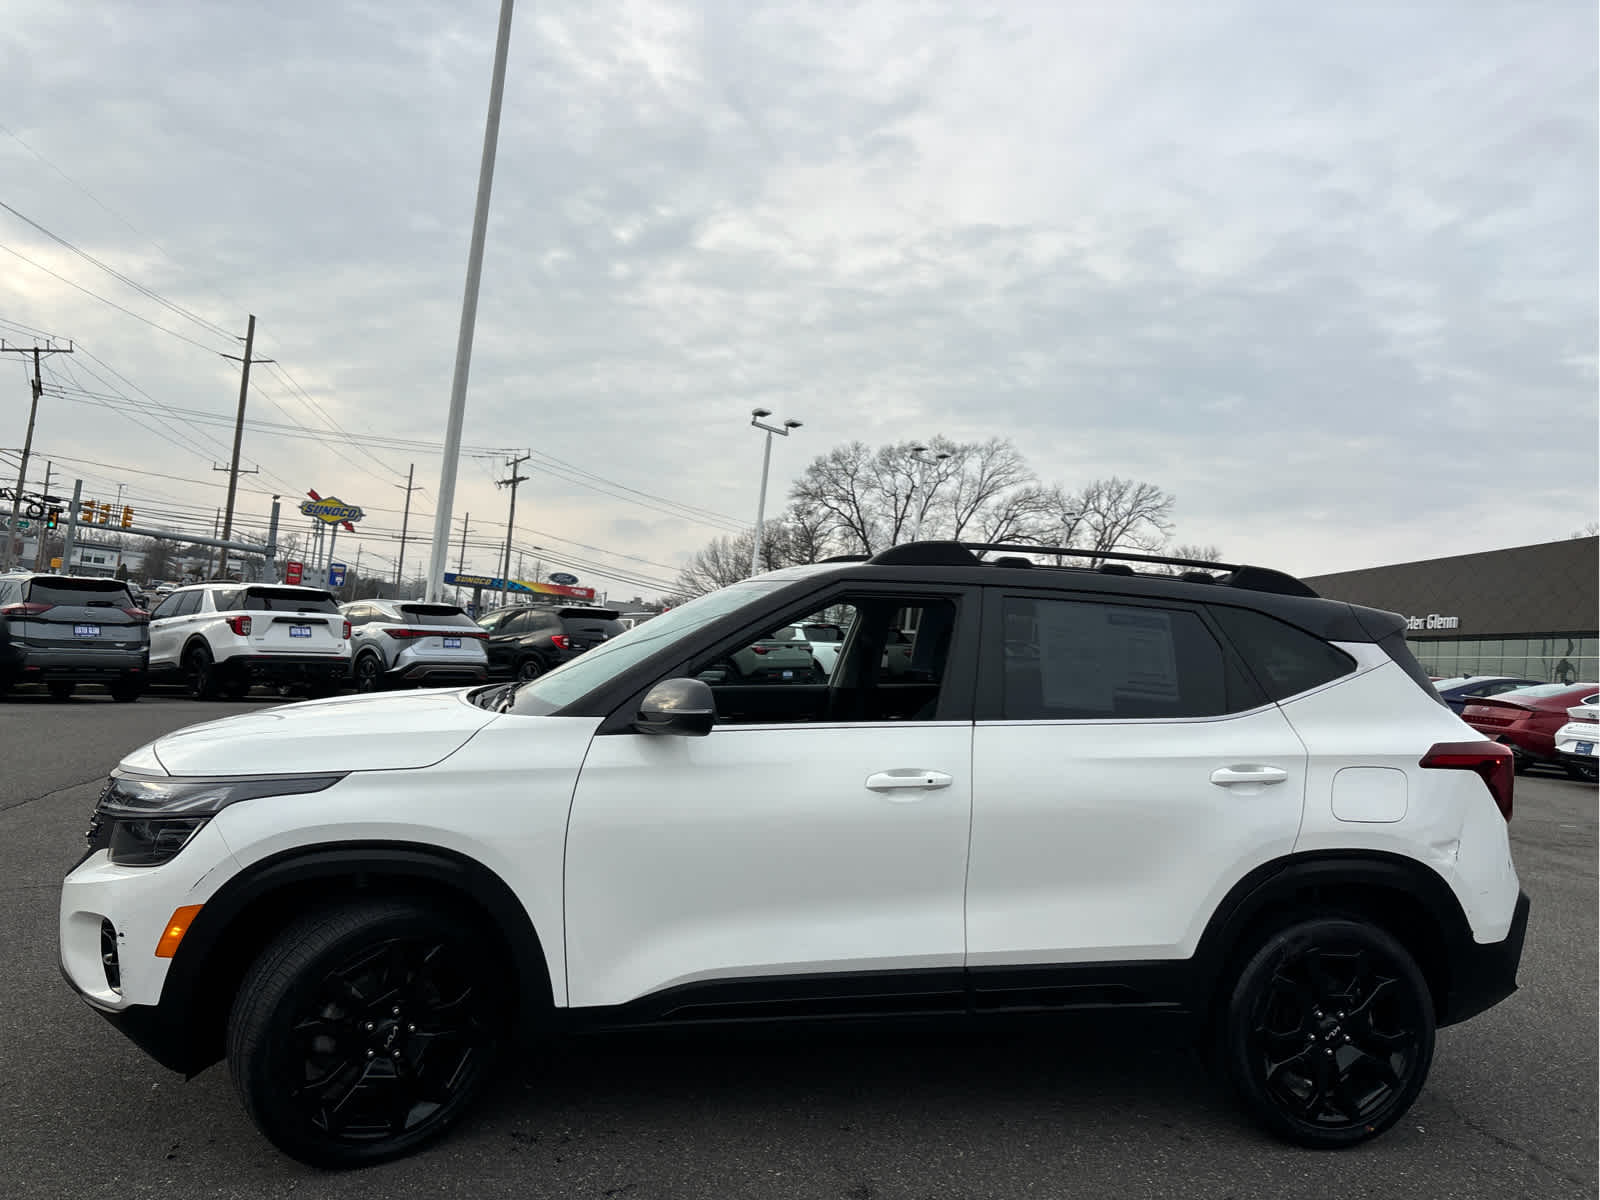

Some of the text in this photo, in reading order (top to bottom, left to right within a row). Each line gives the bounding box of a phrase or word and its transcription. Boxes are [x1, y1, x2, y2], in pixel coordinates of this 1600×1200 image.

[304, 504, 357, 518] SUNOCO
[454, 575, 492, 585] SUNOCO
[1427, 614, 1458, 629] Glenn
